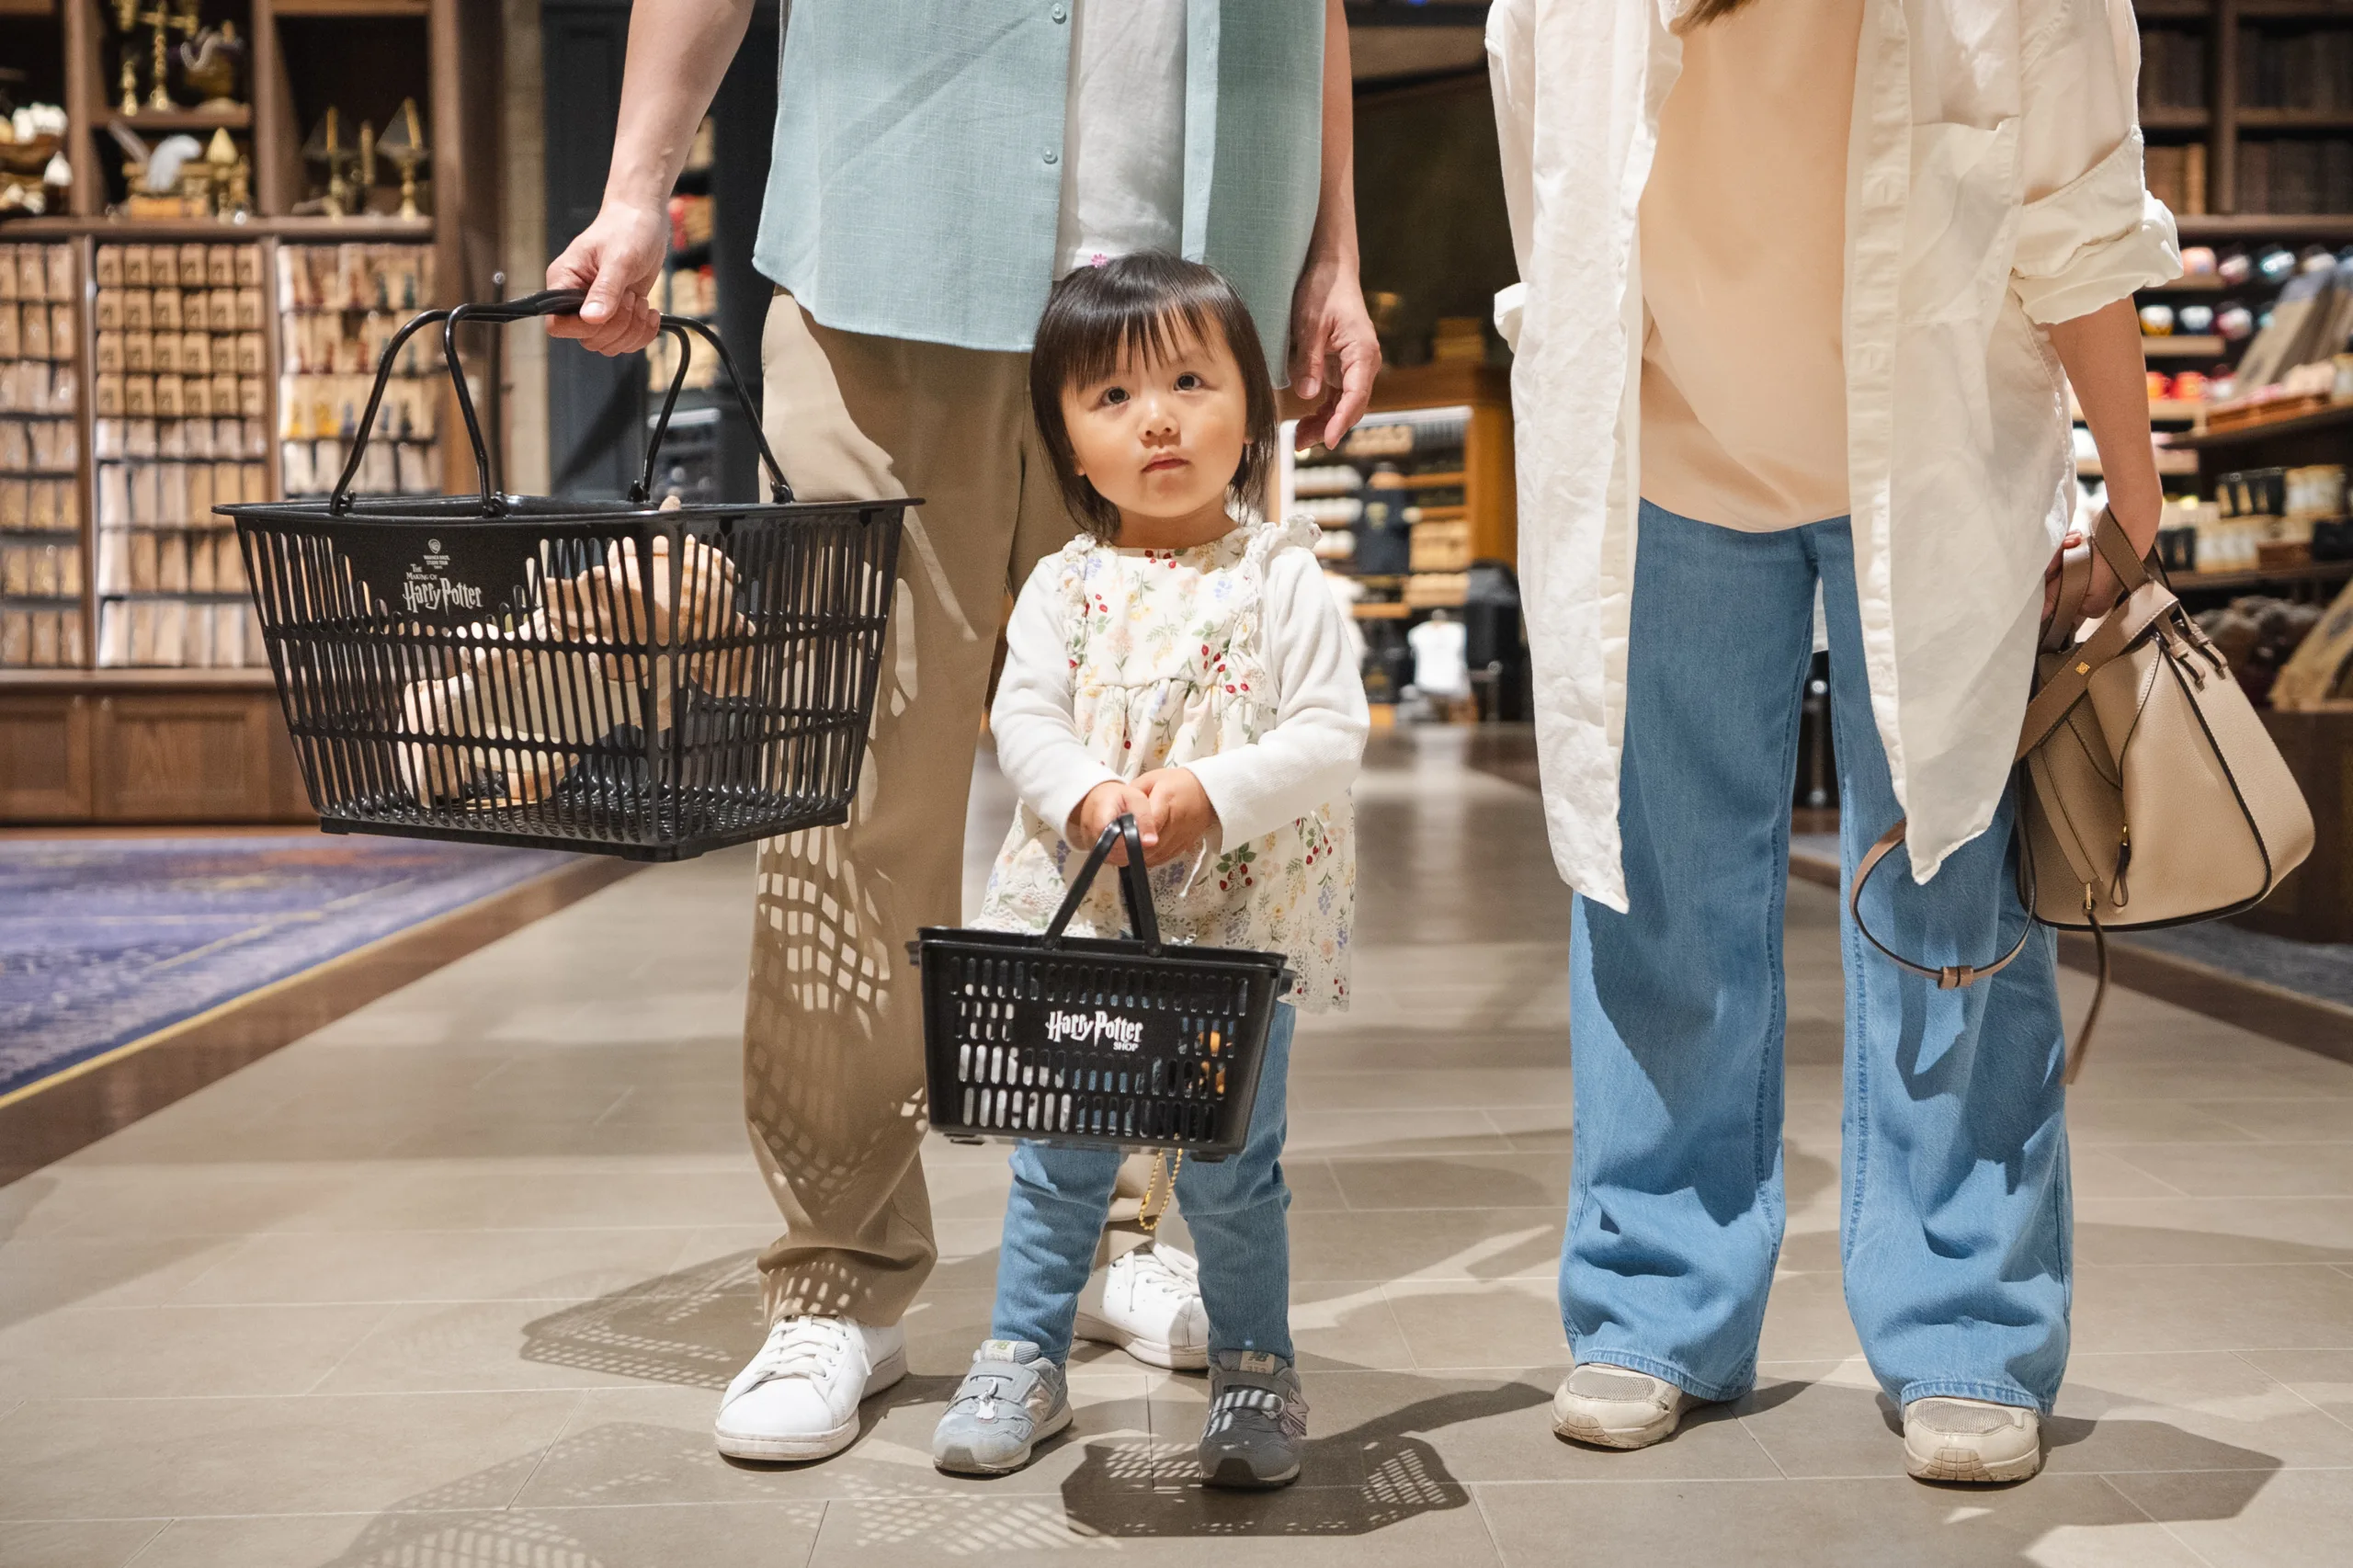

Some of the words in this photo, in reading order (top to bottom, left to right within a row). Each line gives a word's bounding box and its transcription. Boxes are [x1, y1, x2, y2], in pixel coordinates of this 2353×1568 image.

[402, 581, 440, 613] Harry
[439, 577, 483, 616] Potter
[1045, 1010, 1094, 1042] Harry
[1094, 1010, 1143, 1047] Potter
[1113, 1041, 1139, 1051] SHOP
